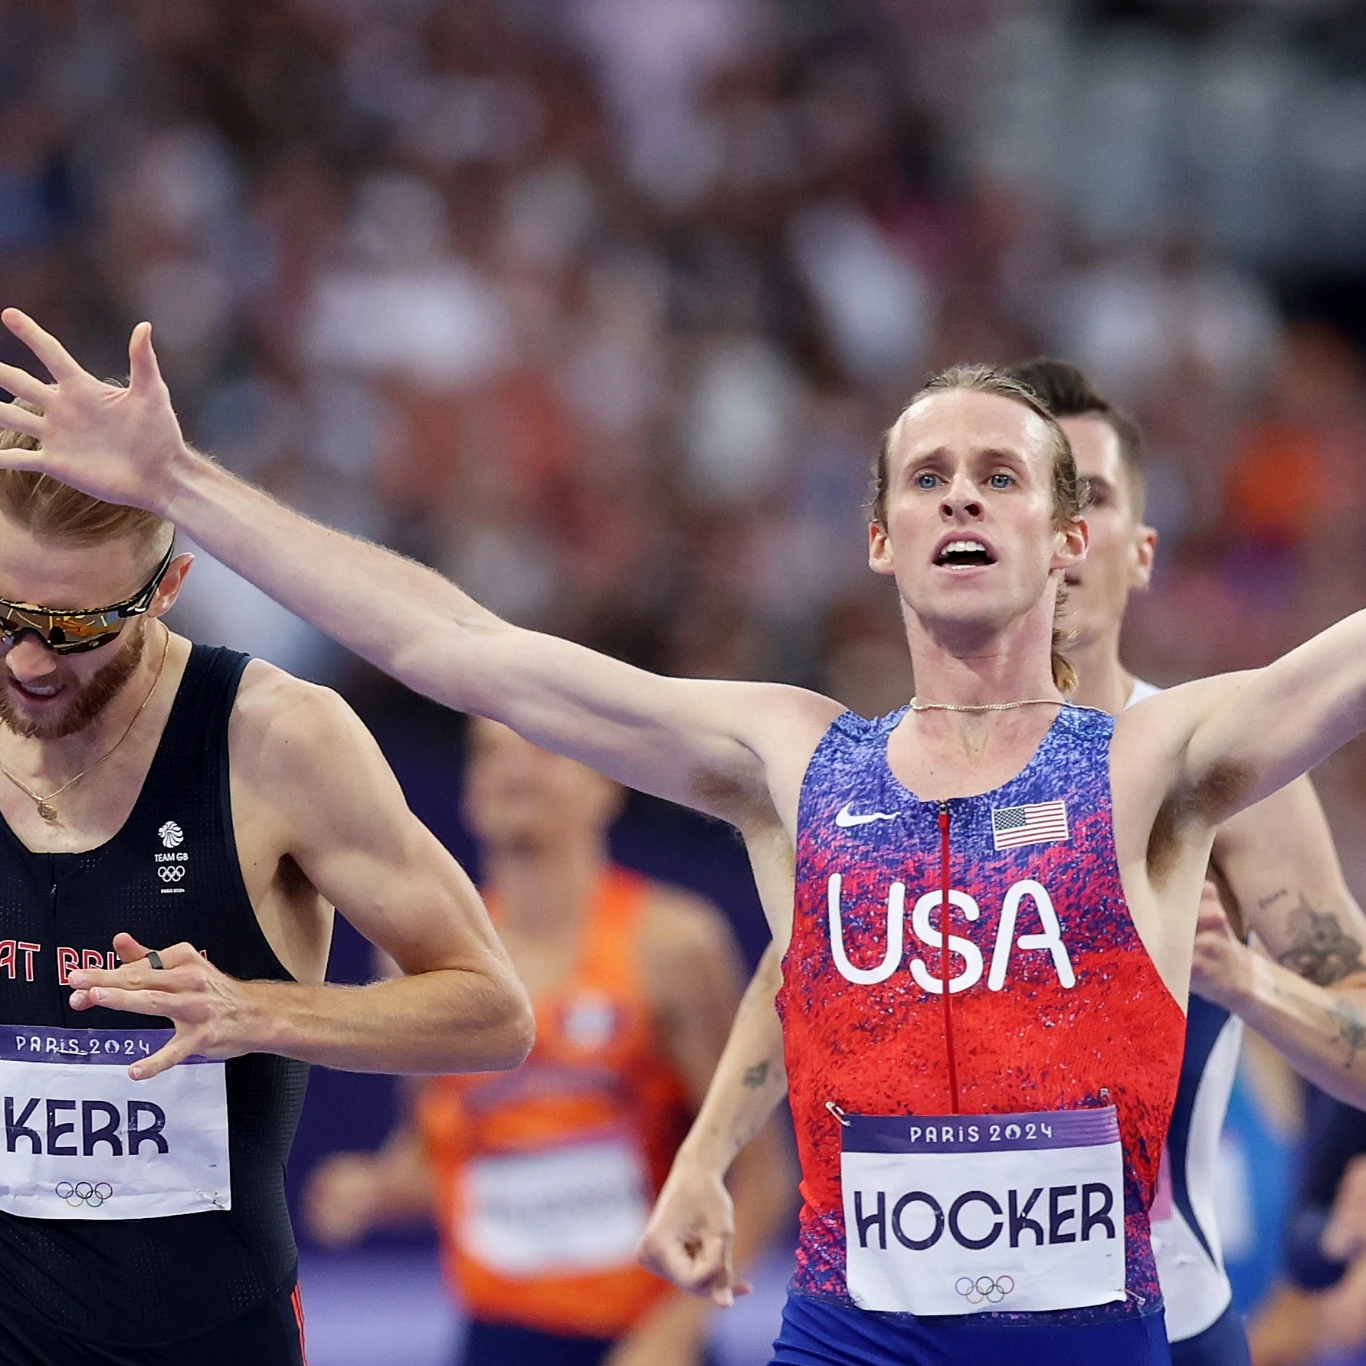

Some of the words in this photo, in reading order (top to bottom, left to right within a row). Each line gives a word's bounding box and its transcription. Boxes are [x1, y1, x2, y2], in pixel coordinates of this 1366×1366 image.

[154, 852, 175, 862] TEAM
[176, 852, 189, 861] GB
[826, 872, 1075, 995] USA
[89, 1039, 150, 1055] 2024
[4, 1096, 169, 1156] KERR
[910, 1125, 980, 1143] PARIS
[989, 1122, 1053, 1142] 2024
[854, 1182, 1115, 1250] HOCKER
